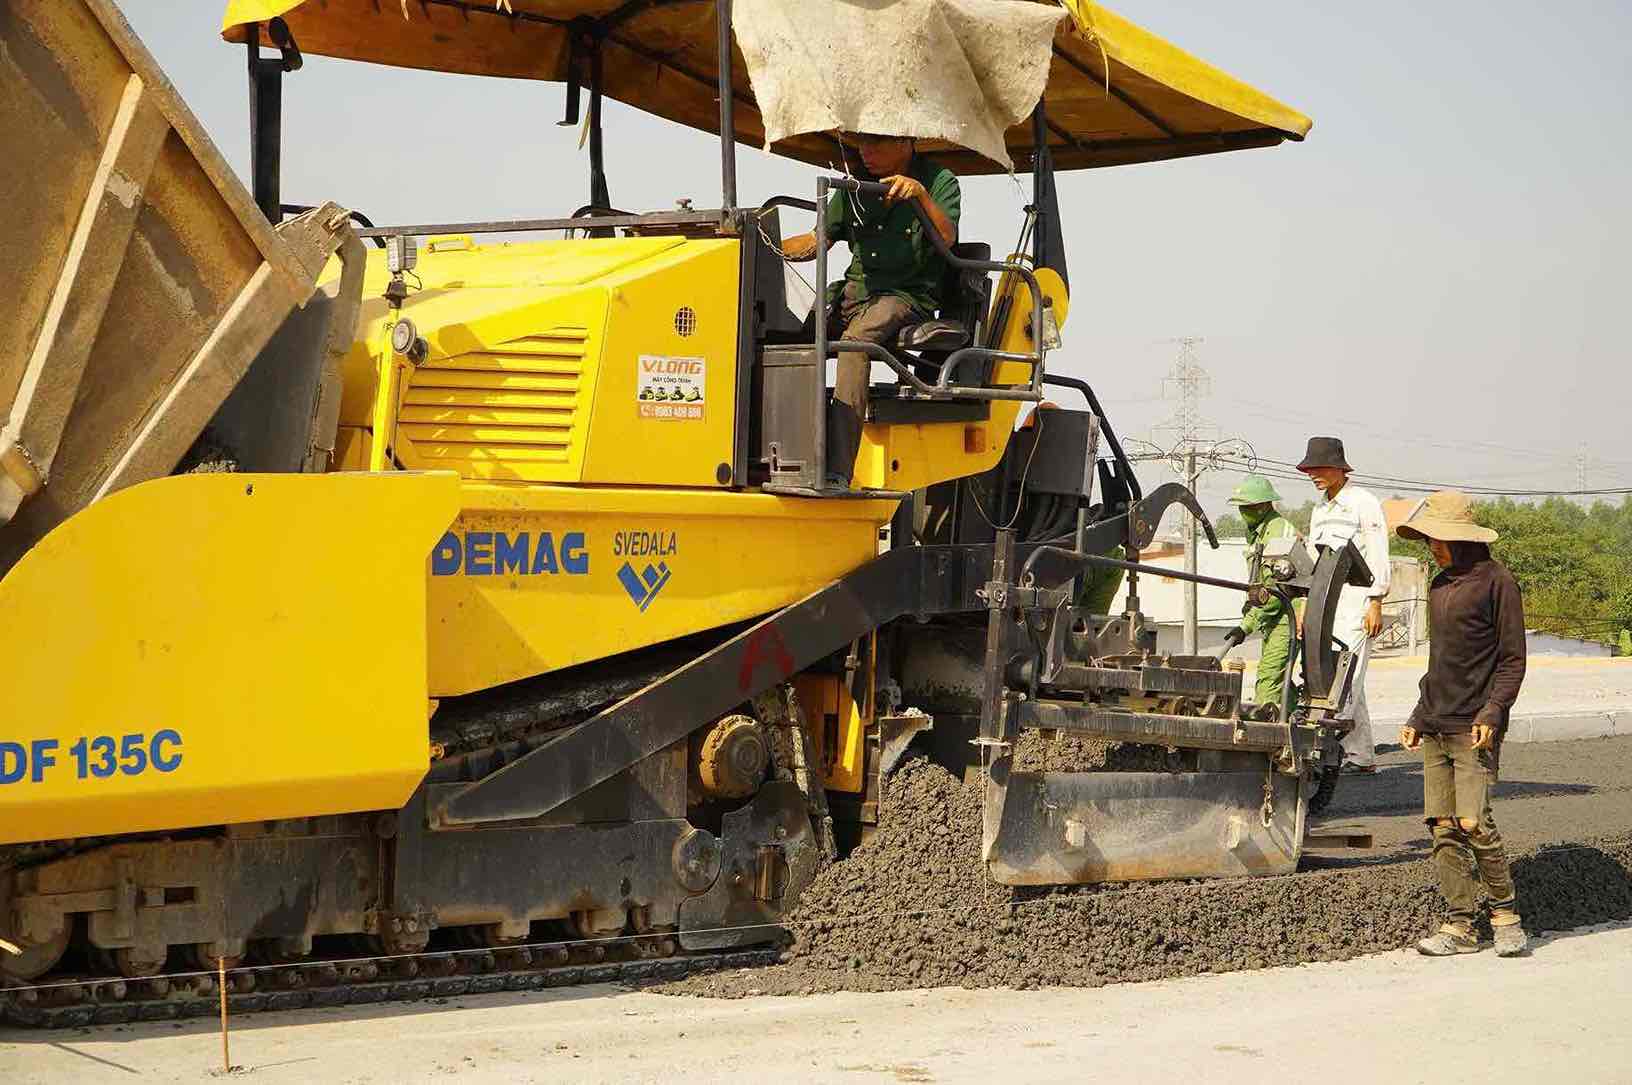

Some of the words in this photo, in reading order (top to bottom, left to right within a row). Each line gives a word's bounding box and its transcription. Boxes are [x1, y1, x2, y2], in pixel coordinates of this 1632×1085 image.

[431, 531, 589, 576] DEMAG
[613, 531, 678, 557] SVEDALA
[69, 729, 183, 779] 135C
